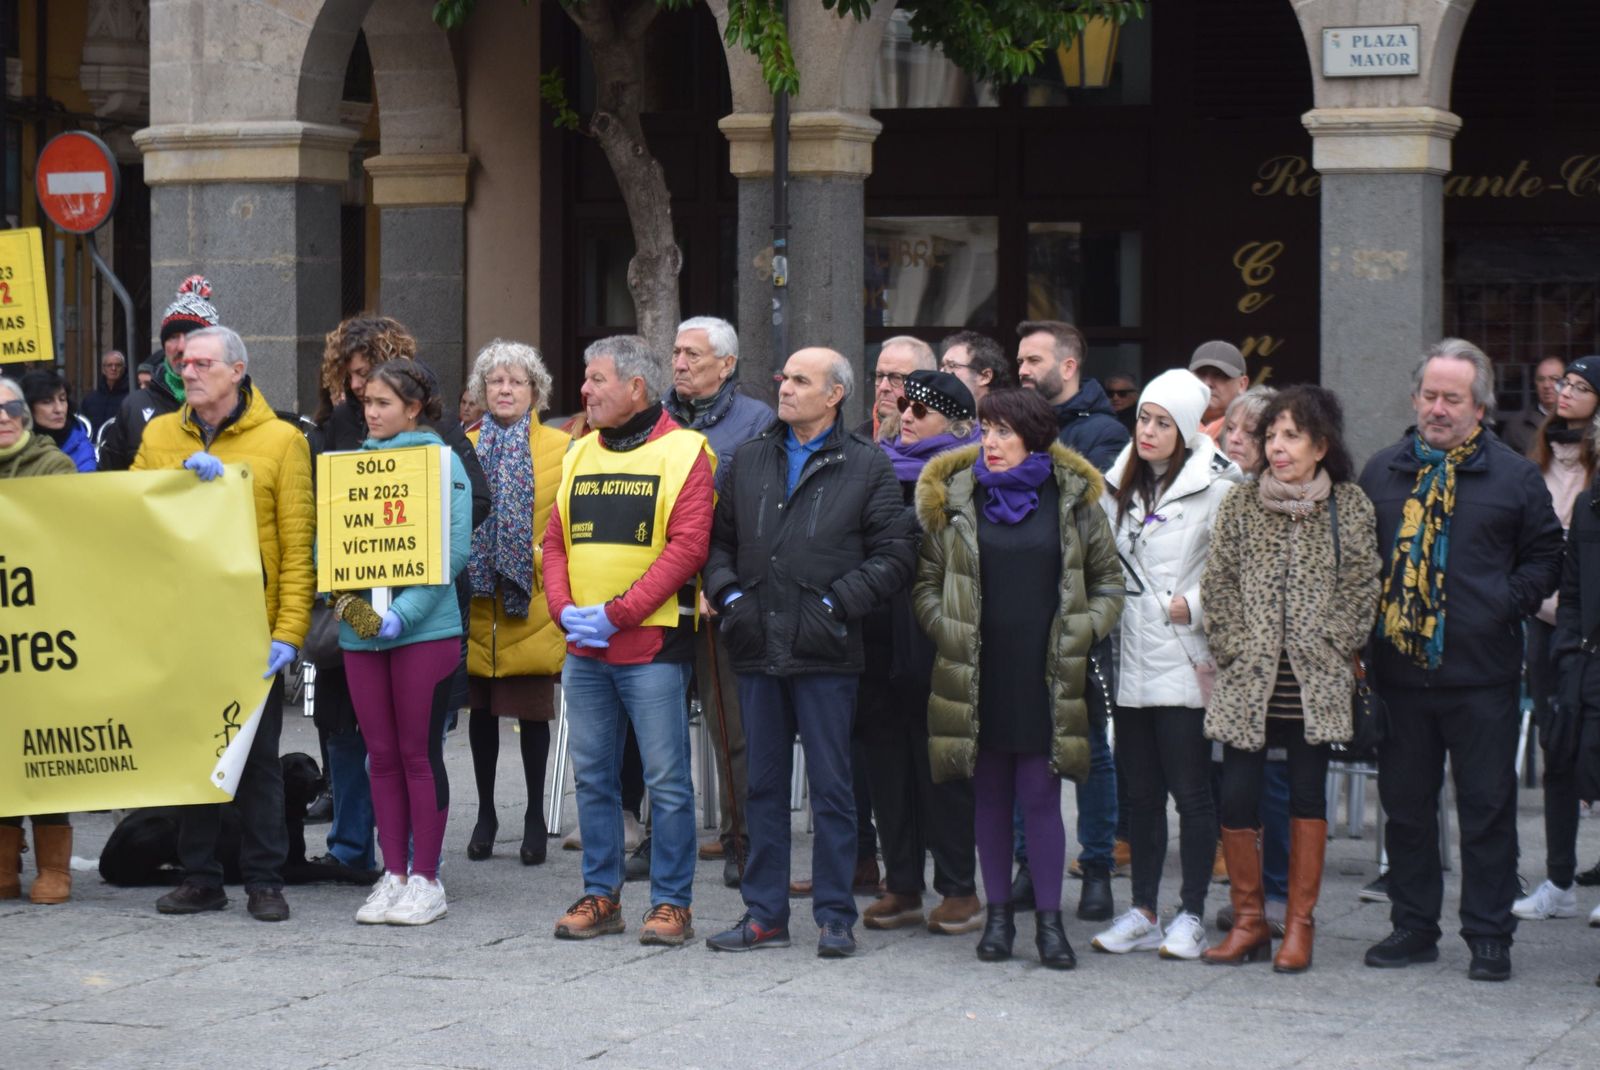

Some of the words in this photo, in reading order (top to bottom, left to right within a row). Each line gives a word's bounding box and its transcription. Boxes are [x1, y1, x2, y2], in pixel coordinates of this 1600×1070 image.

[1352, 32, 1408, 48] PLAZA
[1350, 53, 1410, 67] MAYOR
[3, 337, 36, 356] MÁS
[356, 457, 397, 475] SÓLO
[349, 486, 369, 502] EN
[373, 484, 409, 500] 2023
[574, 481, 600, 497] 100%
[601, 480, 654, 496] ACTIVISTA
[344, 513, 374, 529] VAN
[383, 500, 408, 526] 52
[343, 535, 417, 555] VÍCTIMAS
[334, 568, 350, 582] NI
[356, 565, 388, 580] UNA
[392, 560, 426, 577] MÁS
[23, 718, 133, 756] AMNISTÍA
[25, 753, 138, 778] INTERNACIONAL
